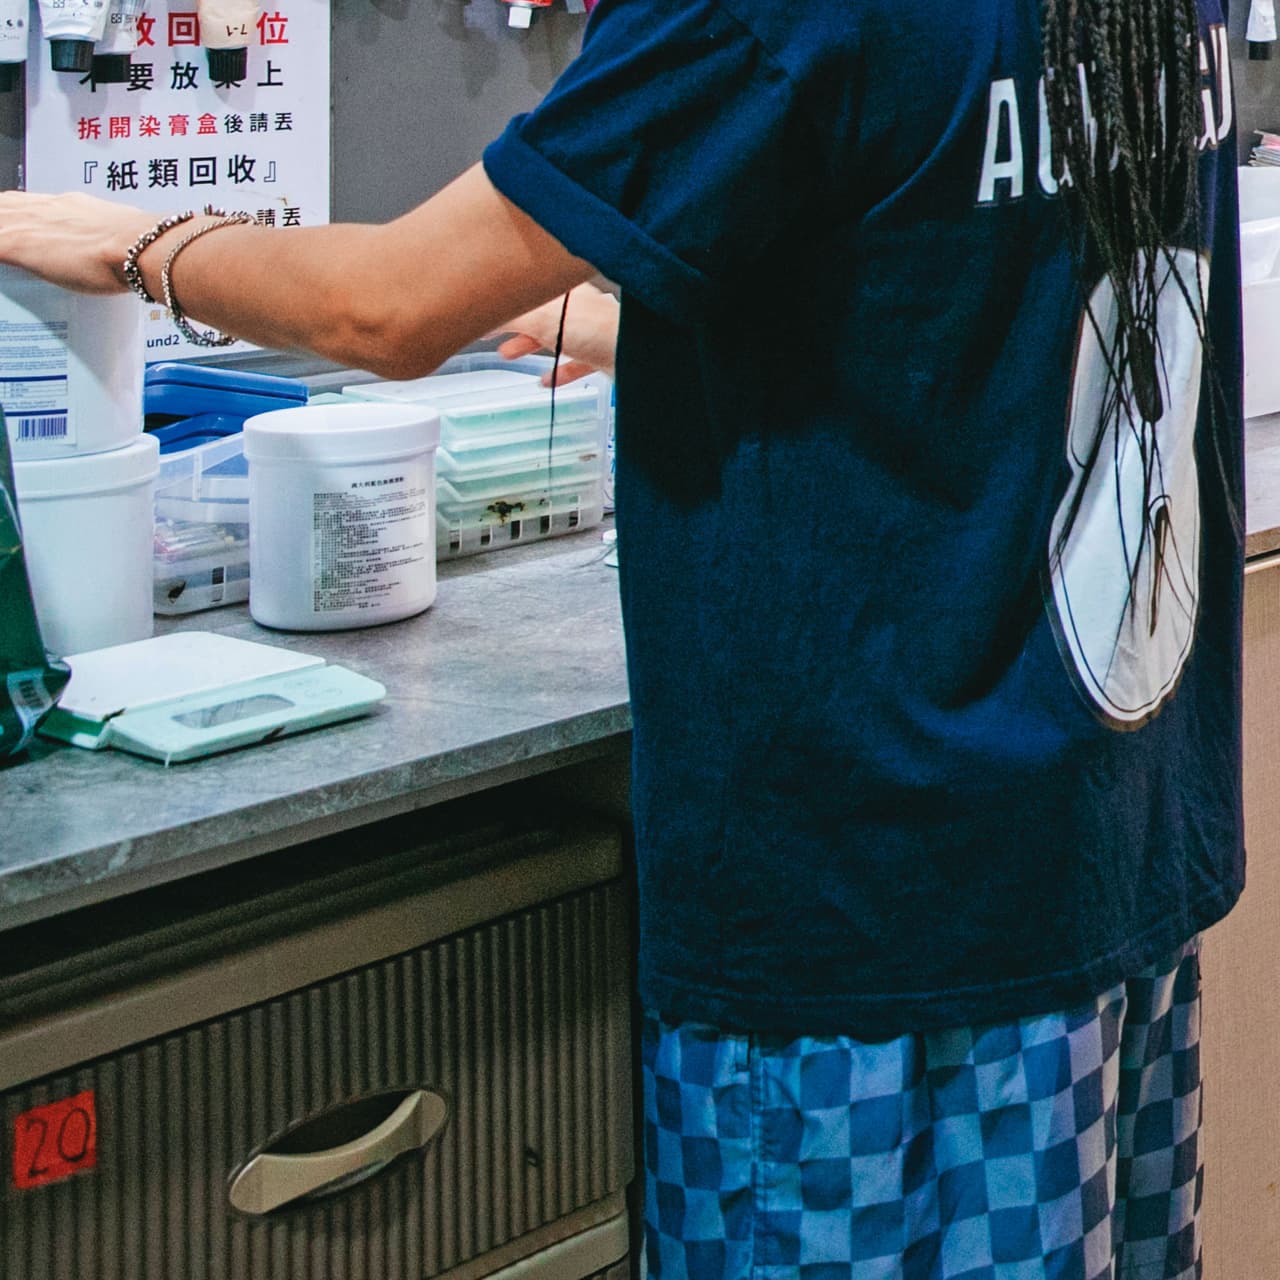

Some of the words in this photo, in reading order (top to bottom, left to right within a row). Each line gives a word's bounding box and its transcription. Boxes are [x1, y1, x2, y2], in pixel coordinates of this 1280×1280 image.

[78, 112, 293, 140] 拆開染膏盒後請丟
[26, 1107, 91, 1179] 20
